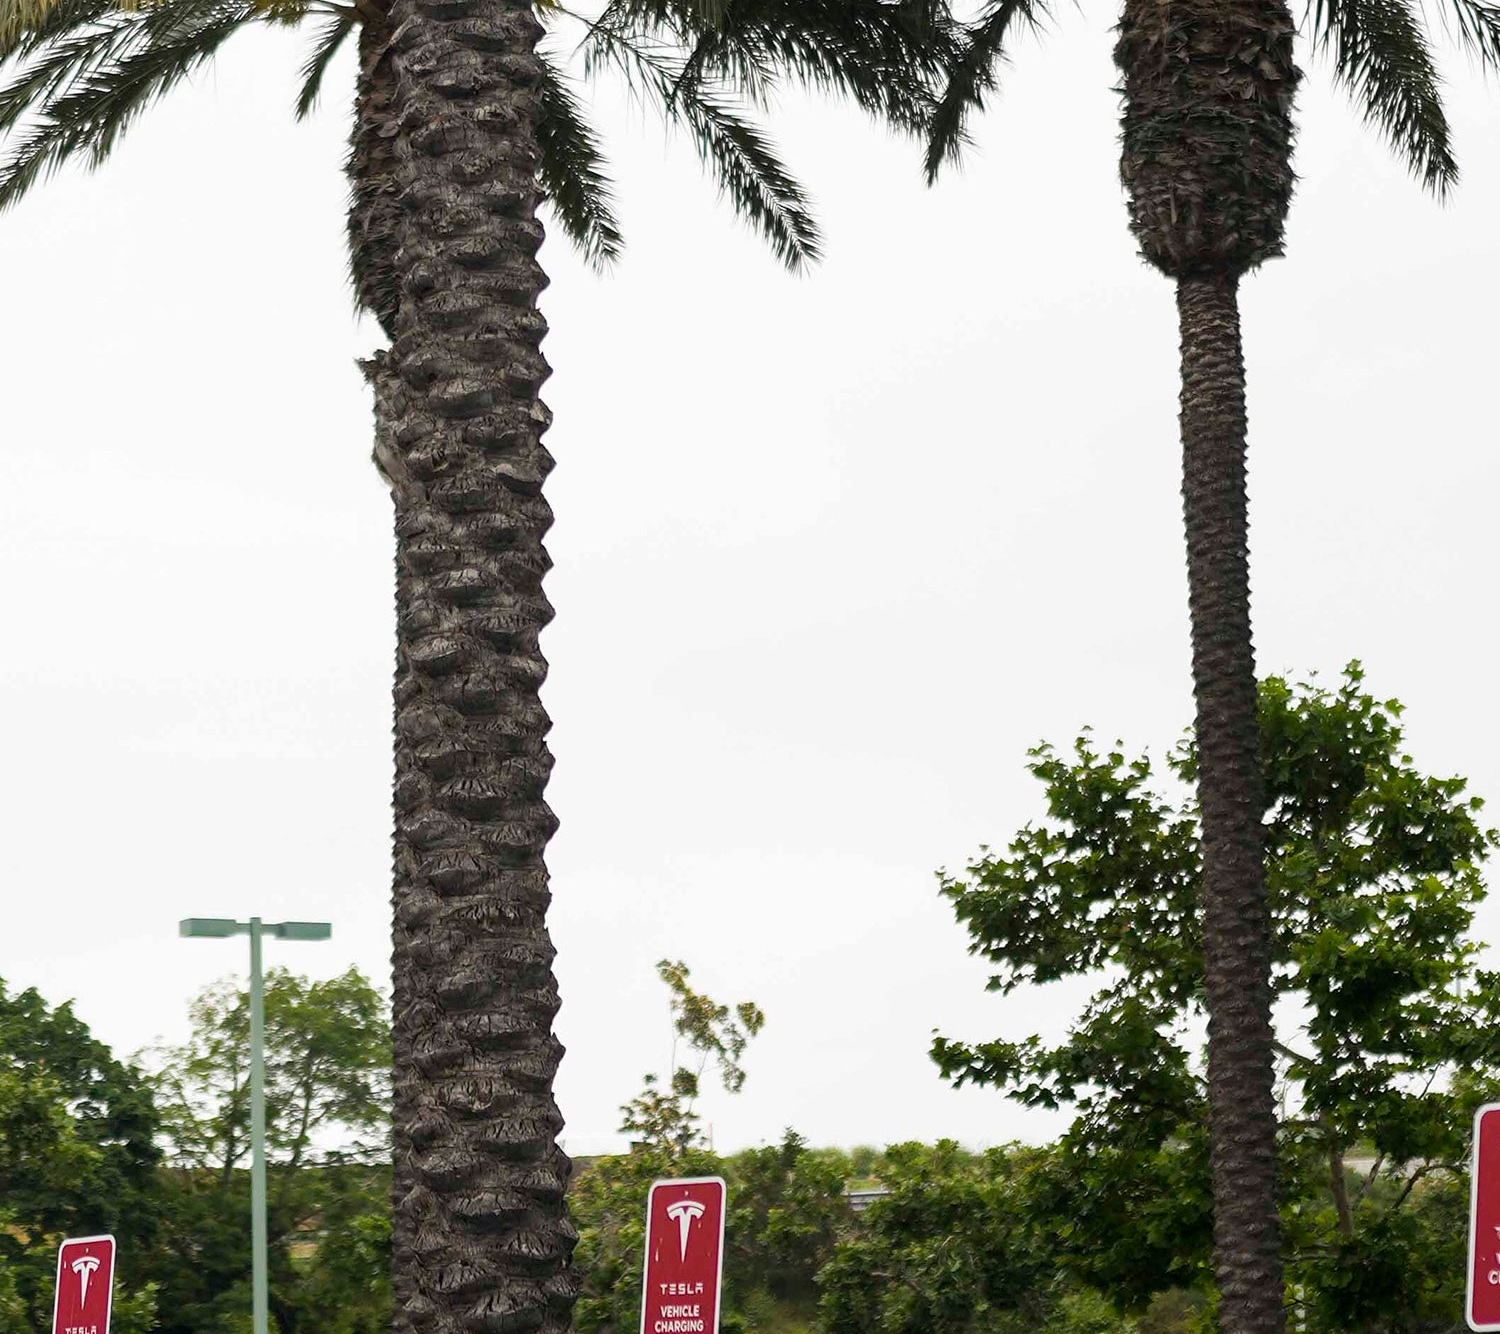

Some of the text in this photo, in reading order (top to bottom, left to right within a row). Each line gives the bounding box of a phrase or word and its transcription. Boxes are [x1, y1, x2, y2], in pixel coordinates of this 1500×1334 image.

[659, 1283, 704, 1295] TESLA
[660, 1305, 700, 1317] VEHICLE
[654, 1319, 704, 1333] CHARGING
